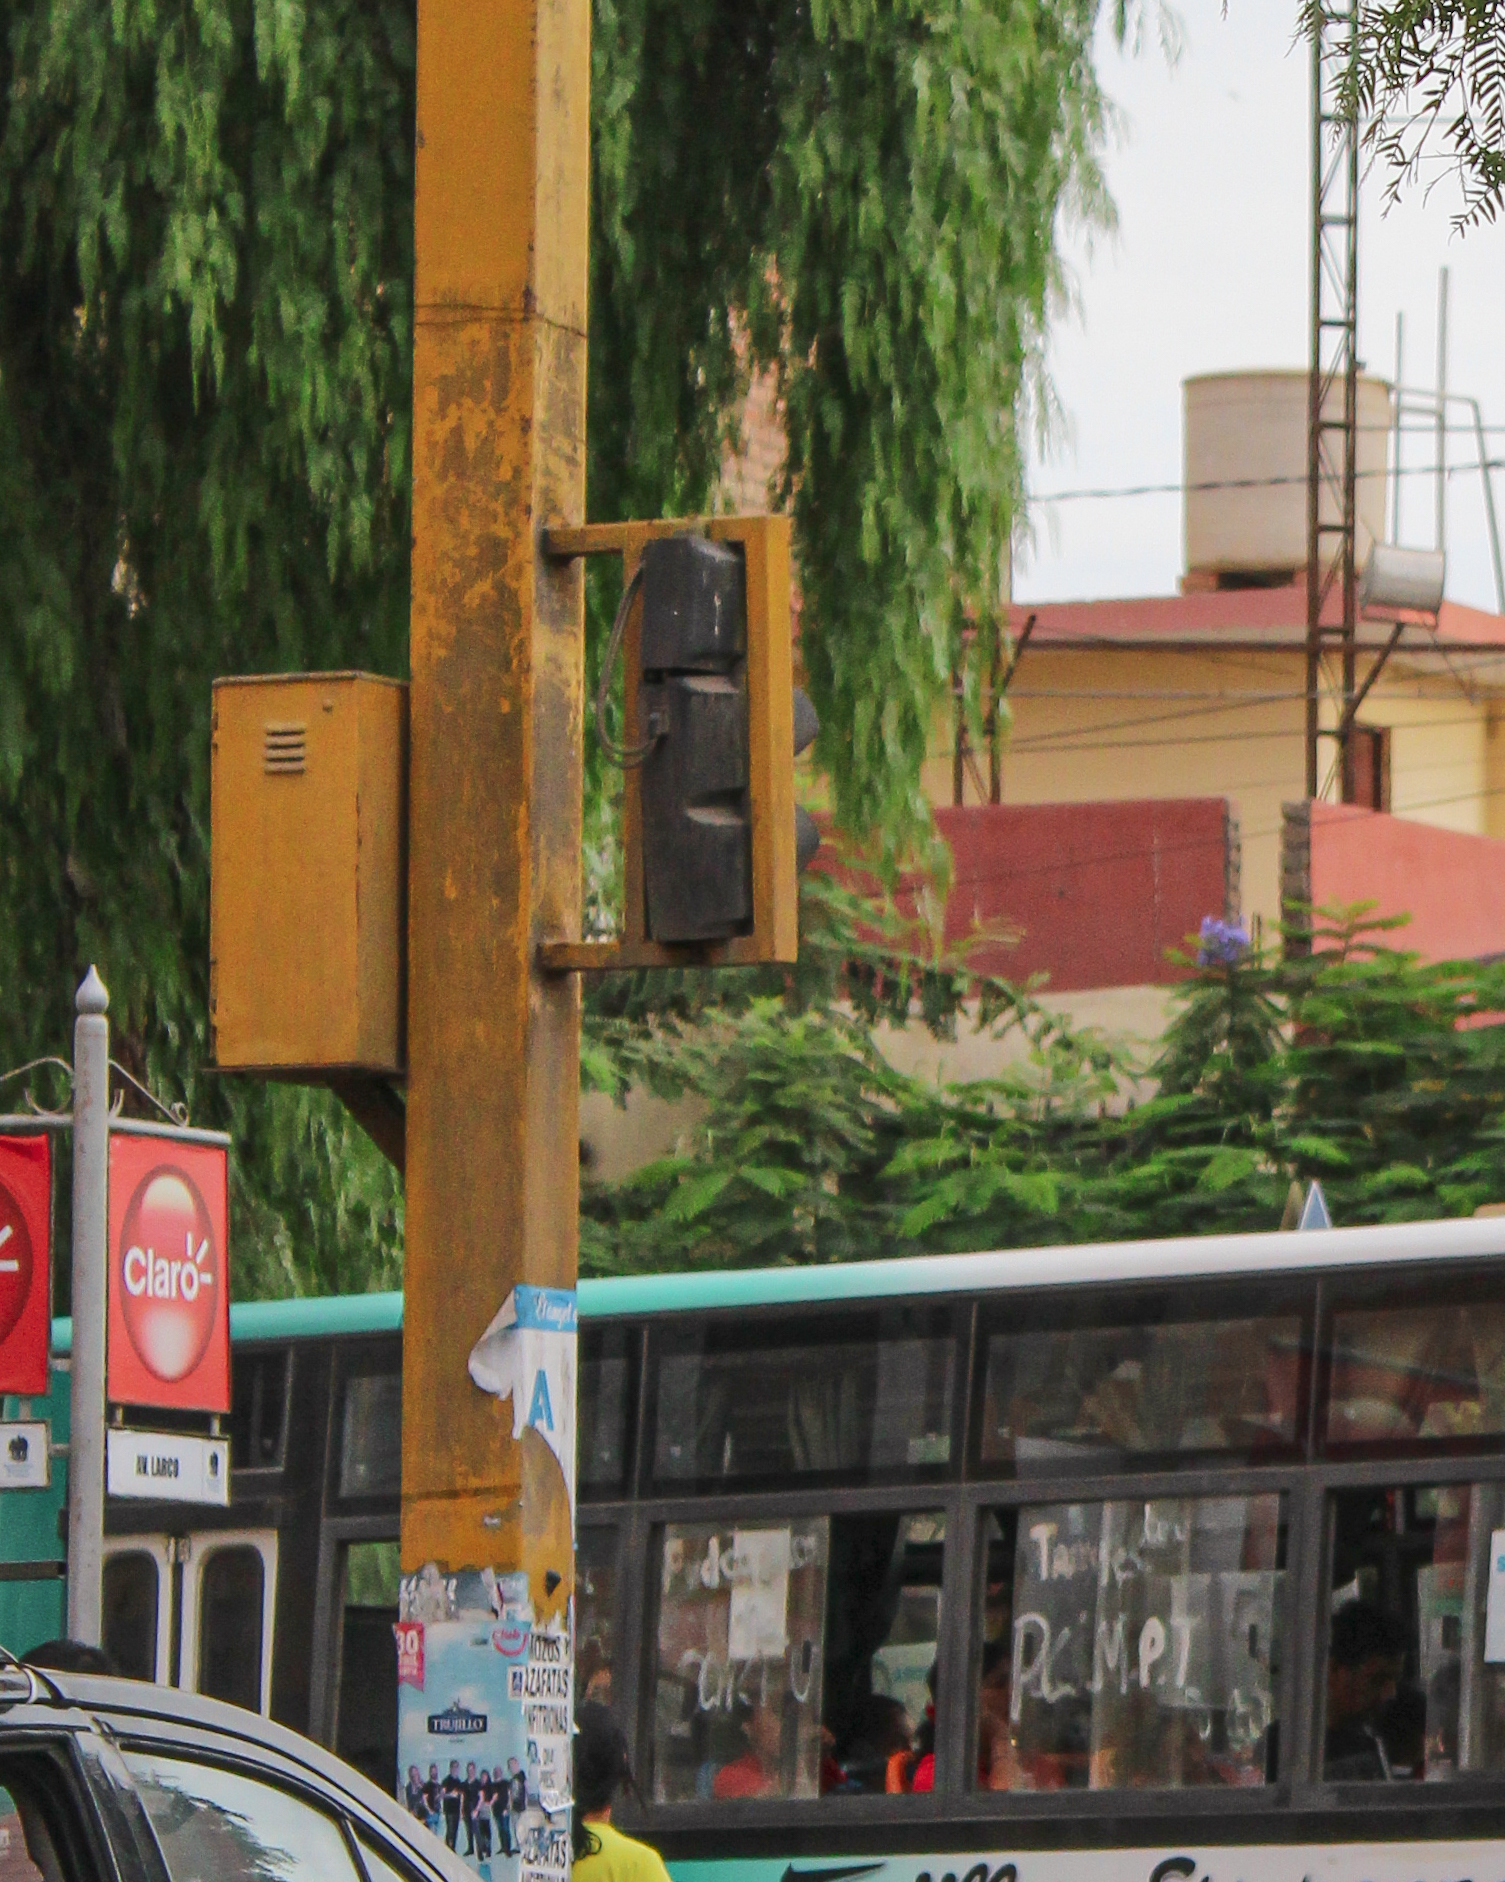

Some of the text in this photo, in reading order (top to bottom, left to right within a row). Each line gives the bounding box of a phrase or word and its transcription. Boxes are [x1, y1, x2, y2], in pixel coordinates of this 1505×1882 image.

[122, 1245, 199, 1303] Claro
[528, 1369, 554, 1431] A
[151, 1455, 180, 1478] LARCO
[432, 1717, 485, 1732] TRUJILLO
